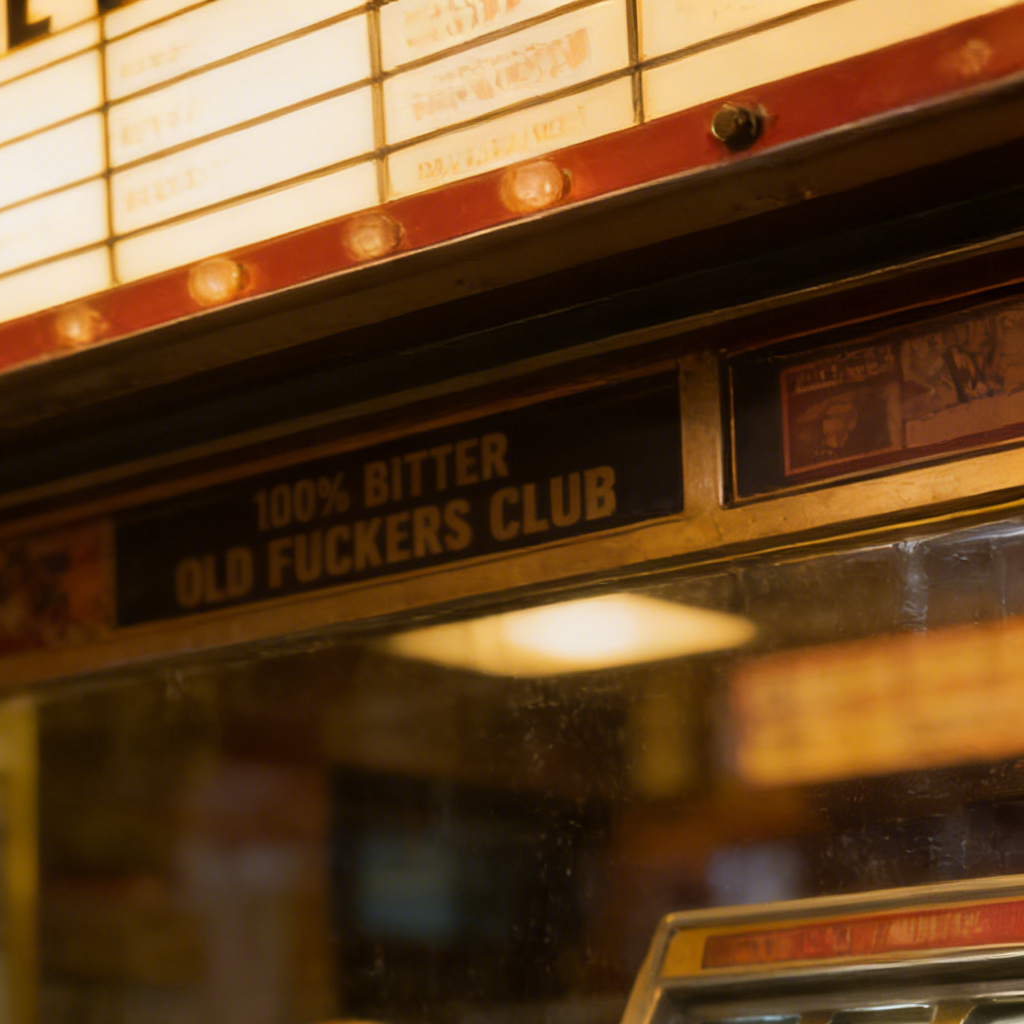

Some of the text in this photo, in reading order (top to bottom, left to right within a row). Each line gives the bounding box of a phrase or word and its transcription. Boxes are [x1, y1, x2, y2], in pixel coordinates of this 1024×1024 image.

[178, 465, 617, 608] OLD FUCKERS CLUB
[255, 433, 509, 531] 100% BITTER
